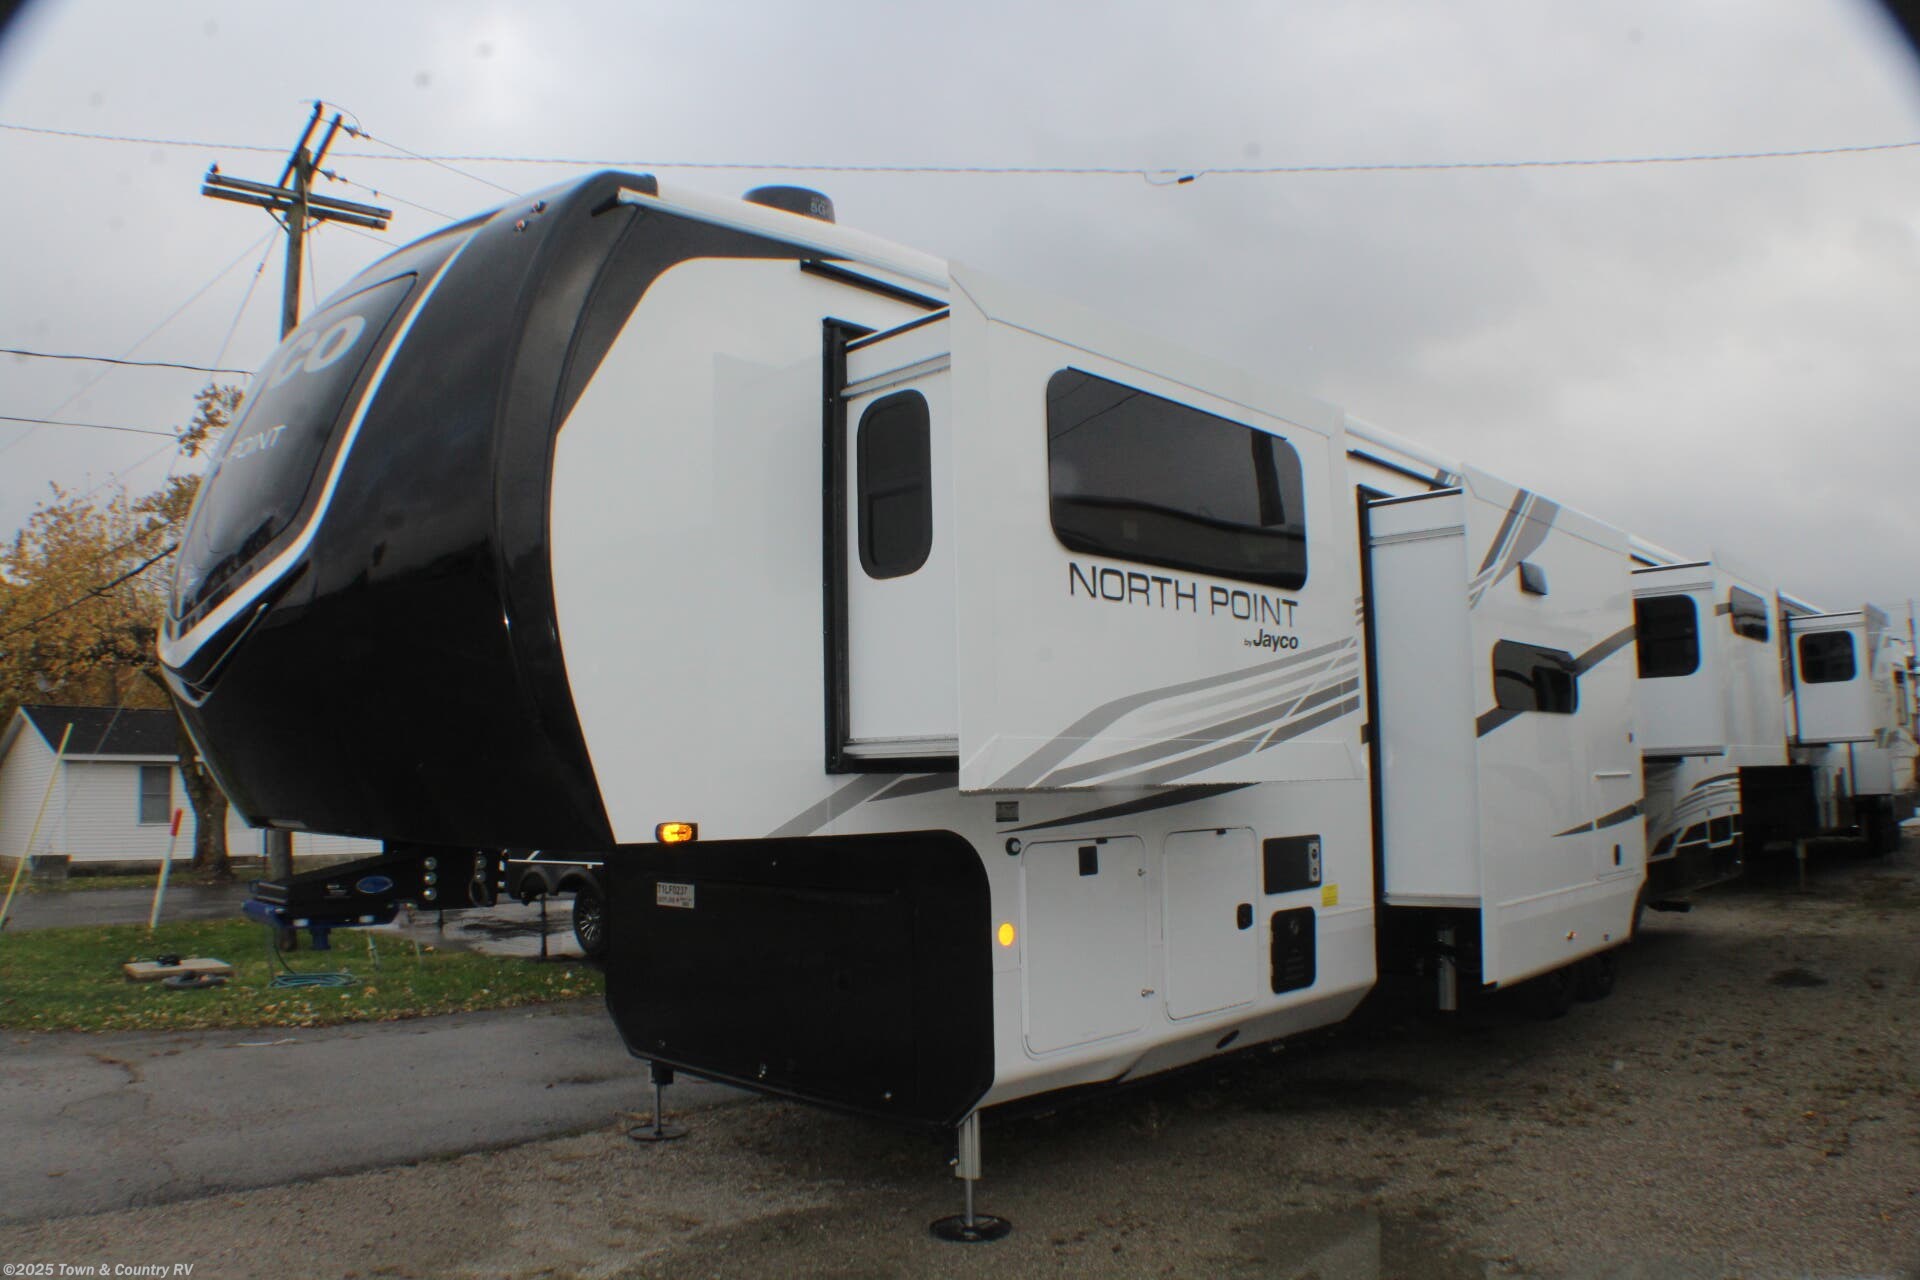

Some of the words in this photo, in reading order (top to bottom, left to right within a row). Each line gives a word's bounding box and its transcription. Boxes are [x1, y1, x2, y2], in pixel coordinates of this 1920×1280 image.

[1068, 562, 1197, 612] NORTH
[1210, 586, 1299, 627] POINT
[1253, 629, 1299, 652] Jayco
